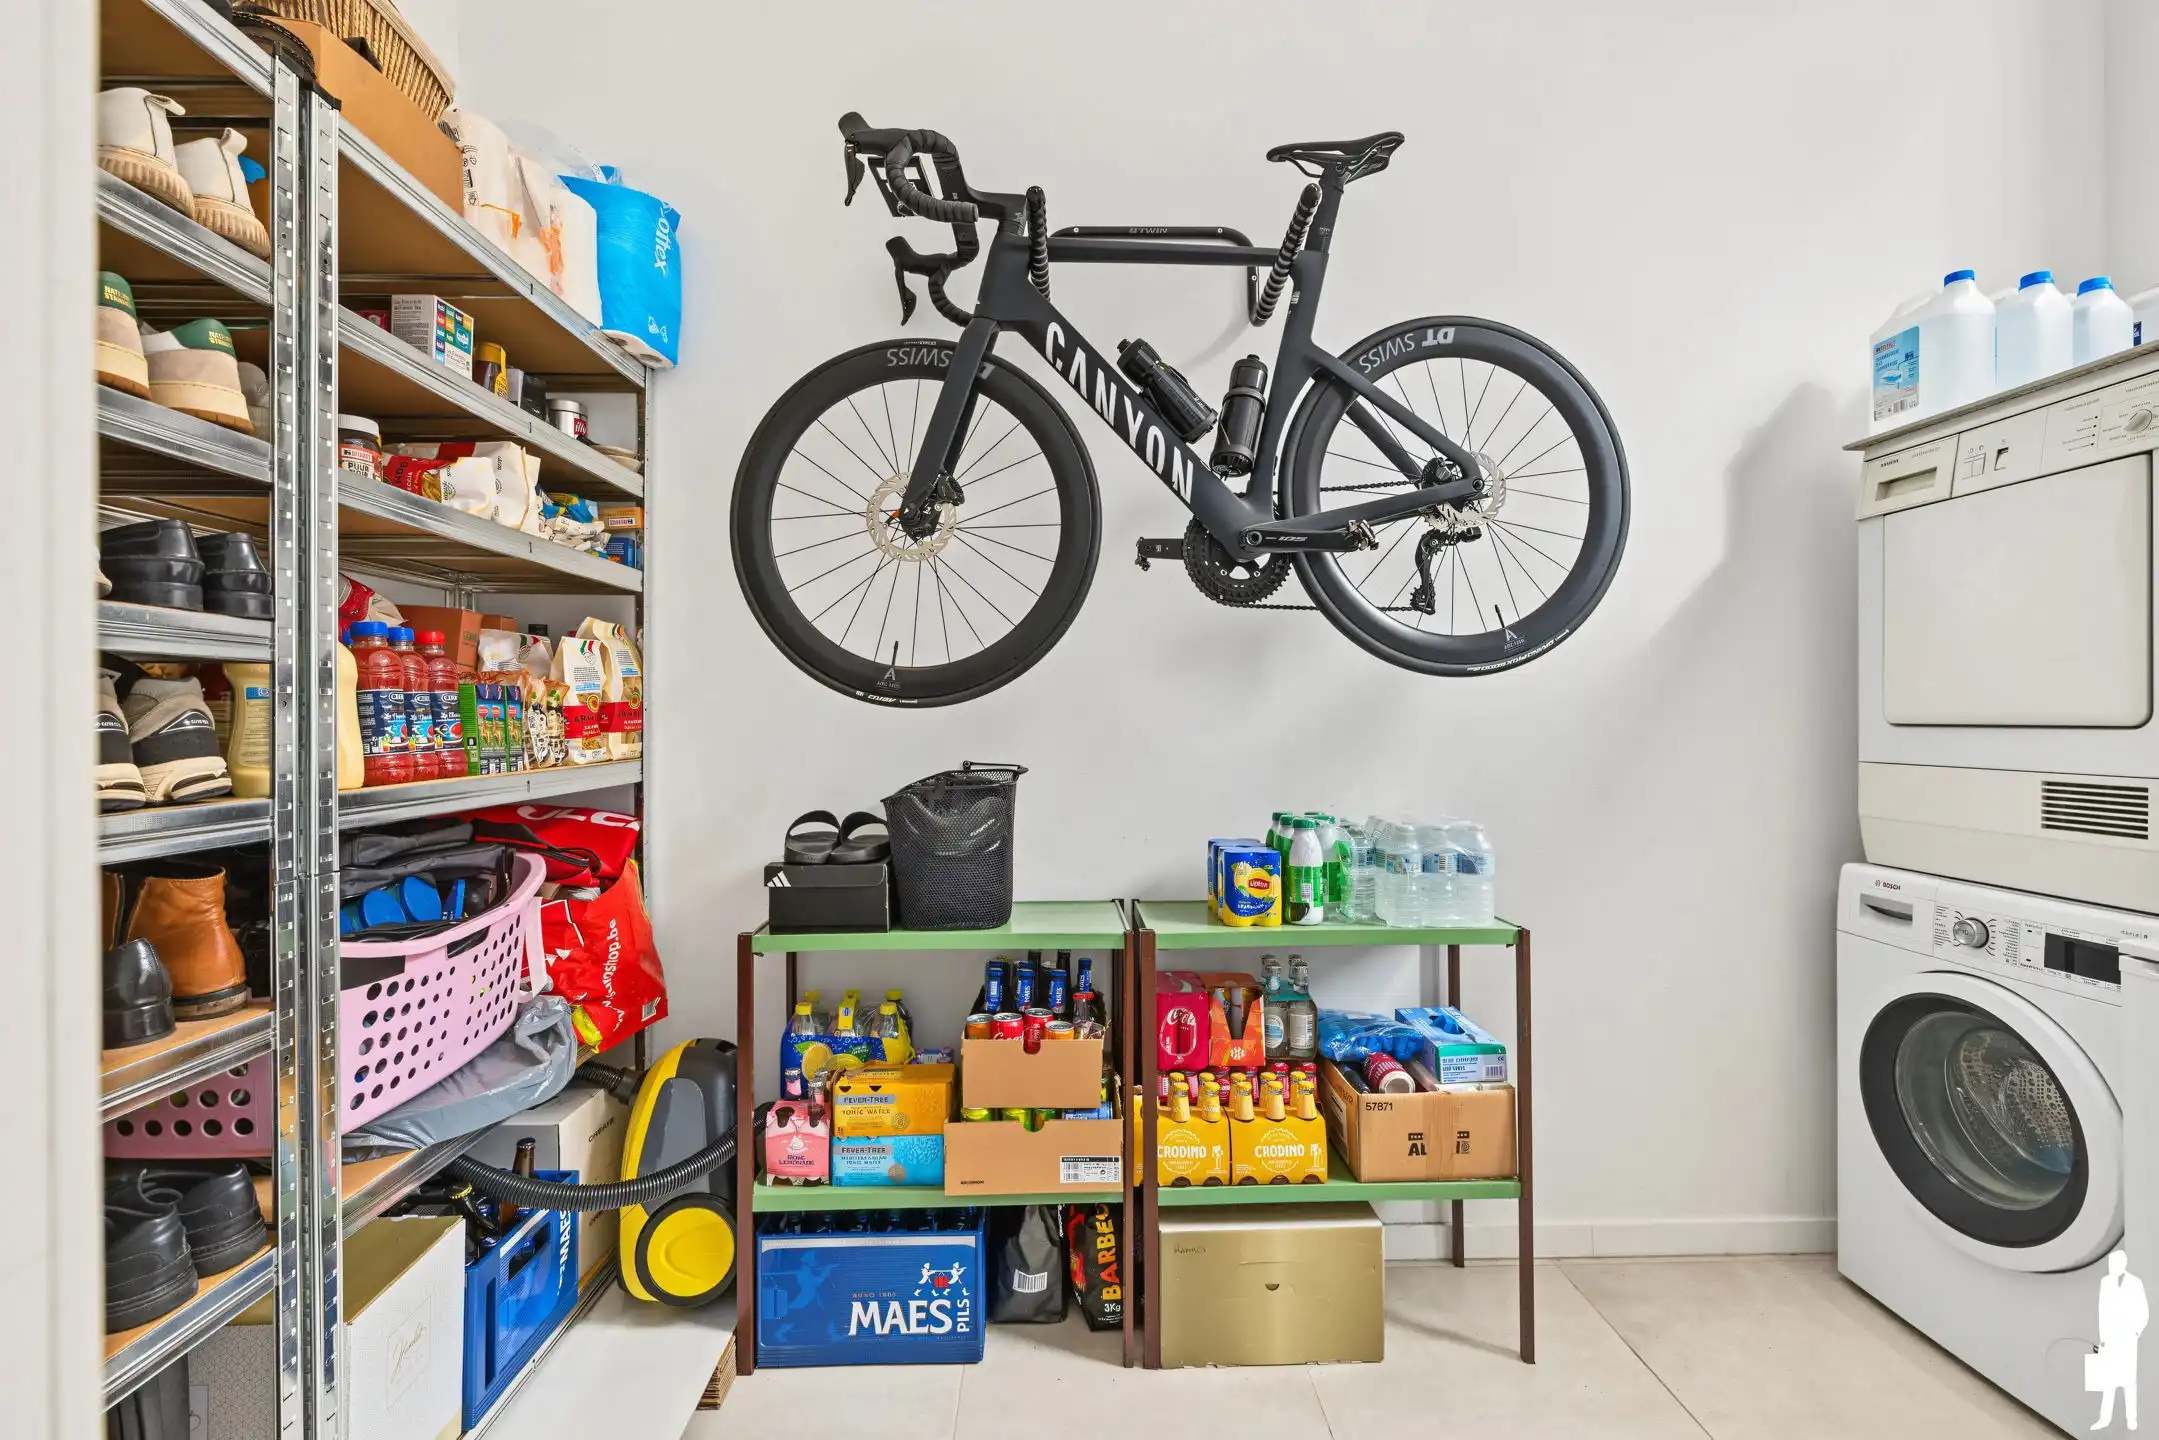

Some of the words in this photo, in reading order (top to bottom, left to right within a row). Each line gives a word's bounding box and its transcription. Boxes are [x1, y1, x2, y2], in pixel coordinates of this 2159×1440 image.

[1421, 327, 1456, 347] DT
[886, 347, 954, 368] SWISS
[1359, 333, 1416, 374] SWISS
[1045, 321, 1194, 505] CANYON
[575, 420, 588, 435] illy
[1365, 1102, 1393, 1111] 57871
[1157, 1145, 1207, 1159] CRODINO
[1254, 1143, 1305, 1158] CRODINO
[848, 1298, 953, 1337] MAES
[956, 1298, 971, 1333] PILS
